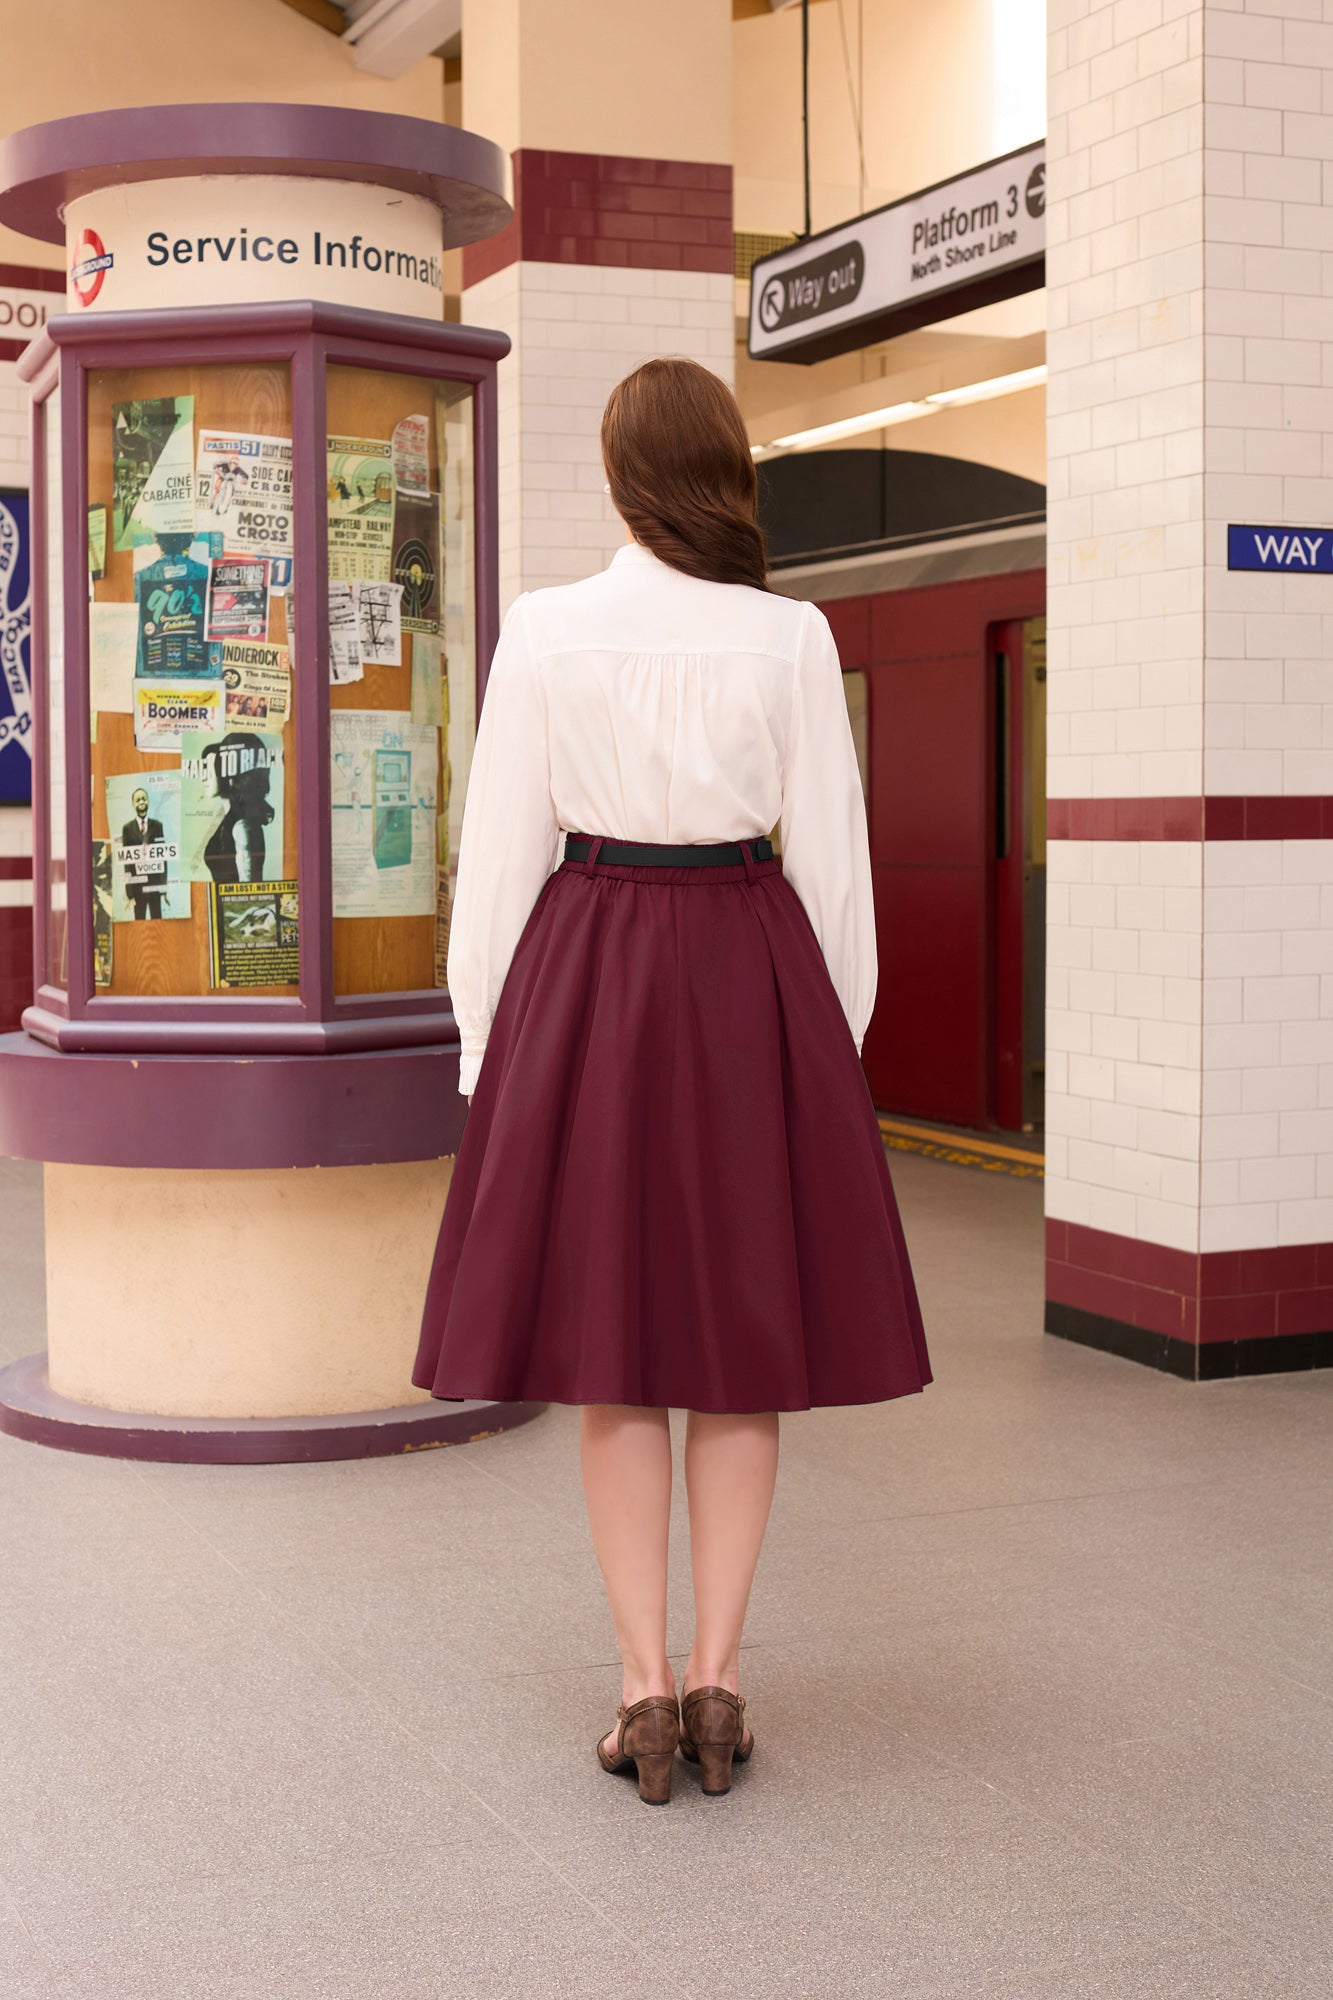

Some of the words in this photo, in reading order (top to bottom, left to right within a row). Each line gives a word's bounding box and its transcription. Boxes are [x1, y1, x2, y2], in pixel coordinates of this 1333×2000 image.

[911, 200, 999, 255] Platform
[1006, 184, 1018, 218] 3
[146, 227, 299, 267] Service
[910, 255, 942, 282] North
[945, 242, 985, 270] Shore
[989, 229, 1018, 254] Line
[788, 273, 824, 310] Way
[827, 257, 857, 295] out
[207, 441, 239, 450] PASTIS
[240, 440, 259, 456] 51
[166, 473, 193, 489] CINÉ
[251, 466, 275, 481] SIDE
[142, 487, 193, 503] CABARET
[198, 480, 211, 497] 12
[237, 511, 290, 530] MOTO
[236, 526, 289, 543] CROSS
[1253, 533, 1325, 567] WAY
[222, 645, 280, 667] INDIEROCK
[147, 702, 209, 720] BOOMER
[219, 750, 238, 778] TO
[240, 747, 284, 775] BLACK
[117, 845, 177, 861] MASER'S
[137, 863, 162, 872] VOICE
[257, 882, 271, 891] NOT
